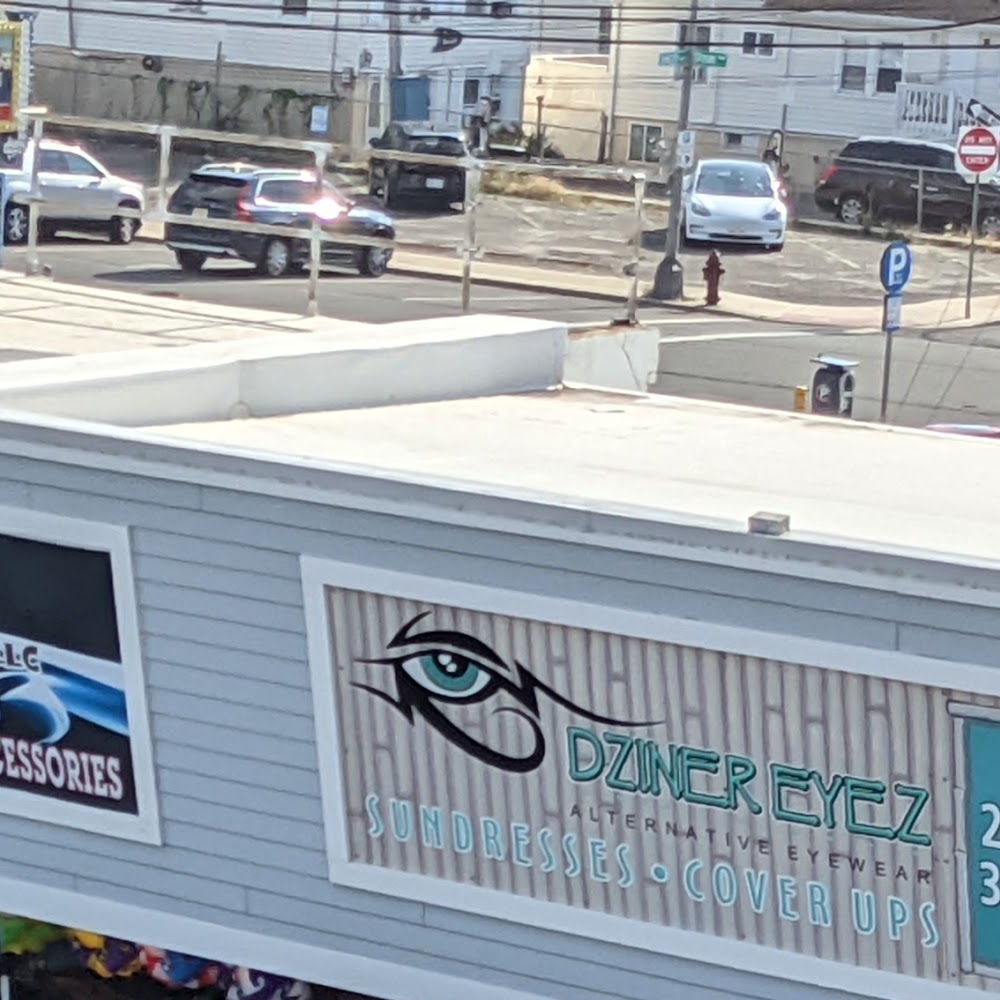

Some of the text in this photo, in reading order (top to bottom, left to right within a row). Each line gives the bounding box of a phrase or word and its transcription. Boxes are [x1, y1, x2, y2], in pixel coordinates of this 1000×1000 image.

[888, 247, 907, 286] P
[566, 725, 932, 847] DZINER EYEZ
[365, 792, 939, 949] SUNDRESSES COVER UPS
[569, 803, 932, 885] ALTERNATIVE EYEWEAR
